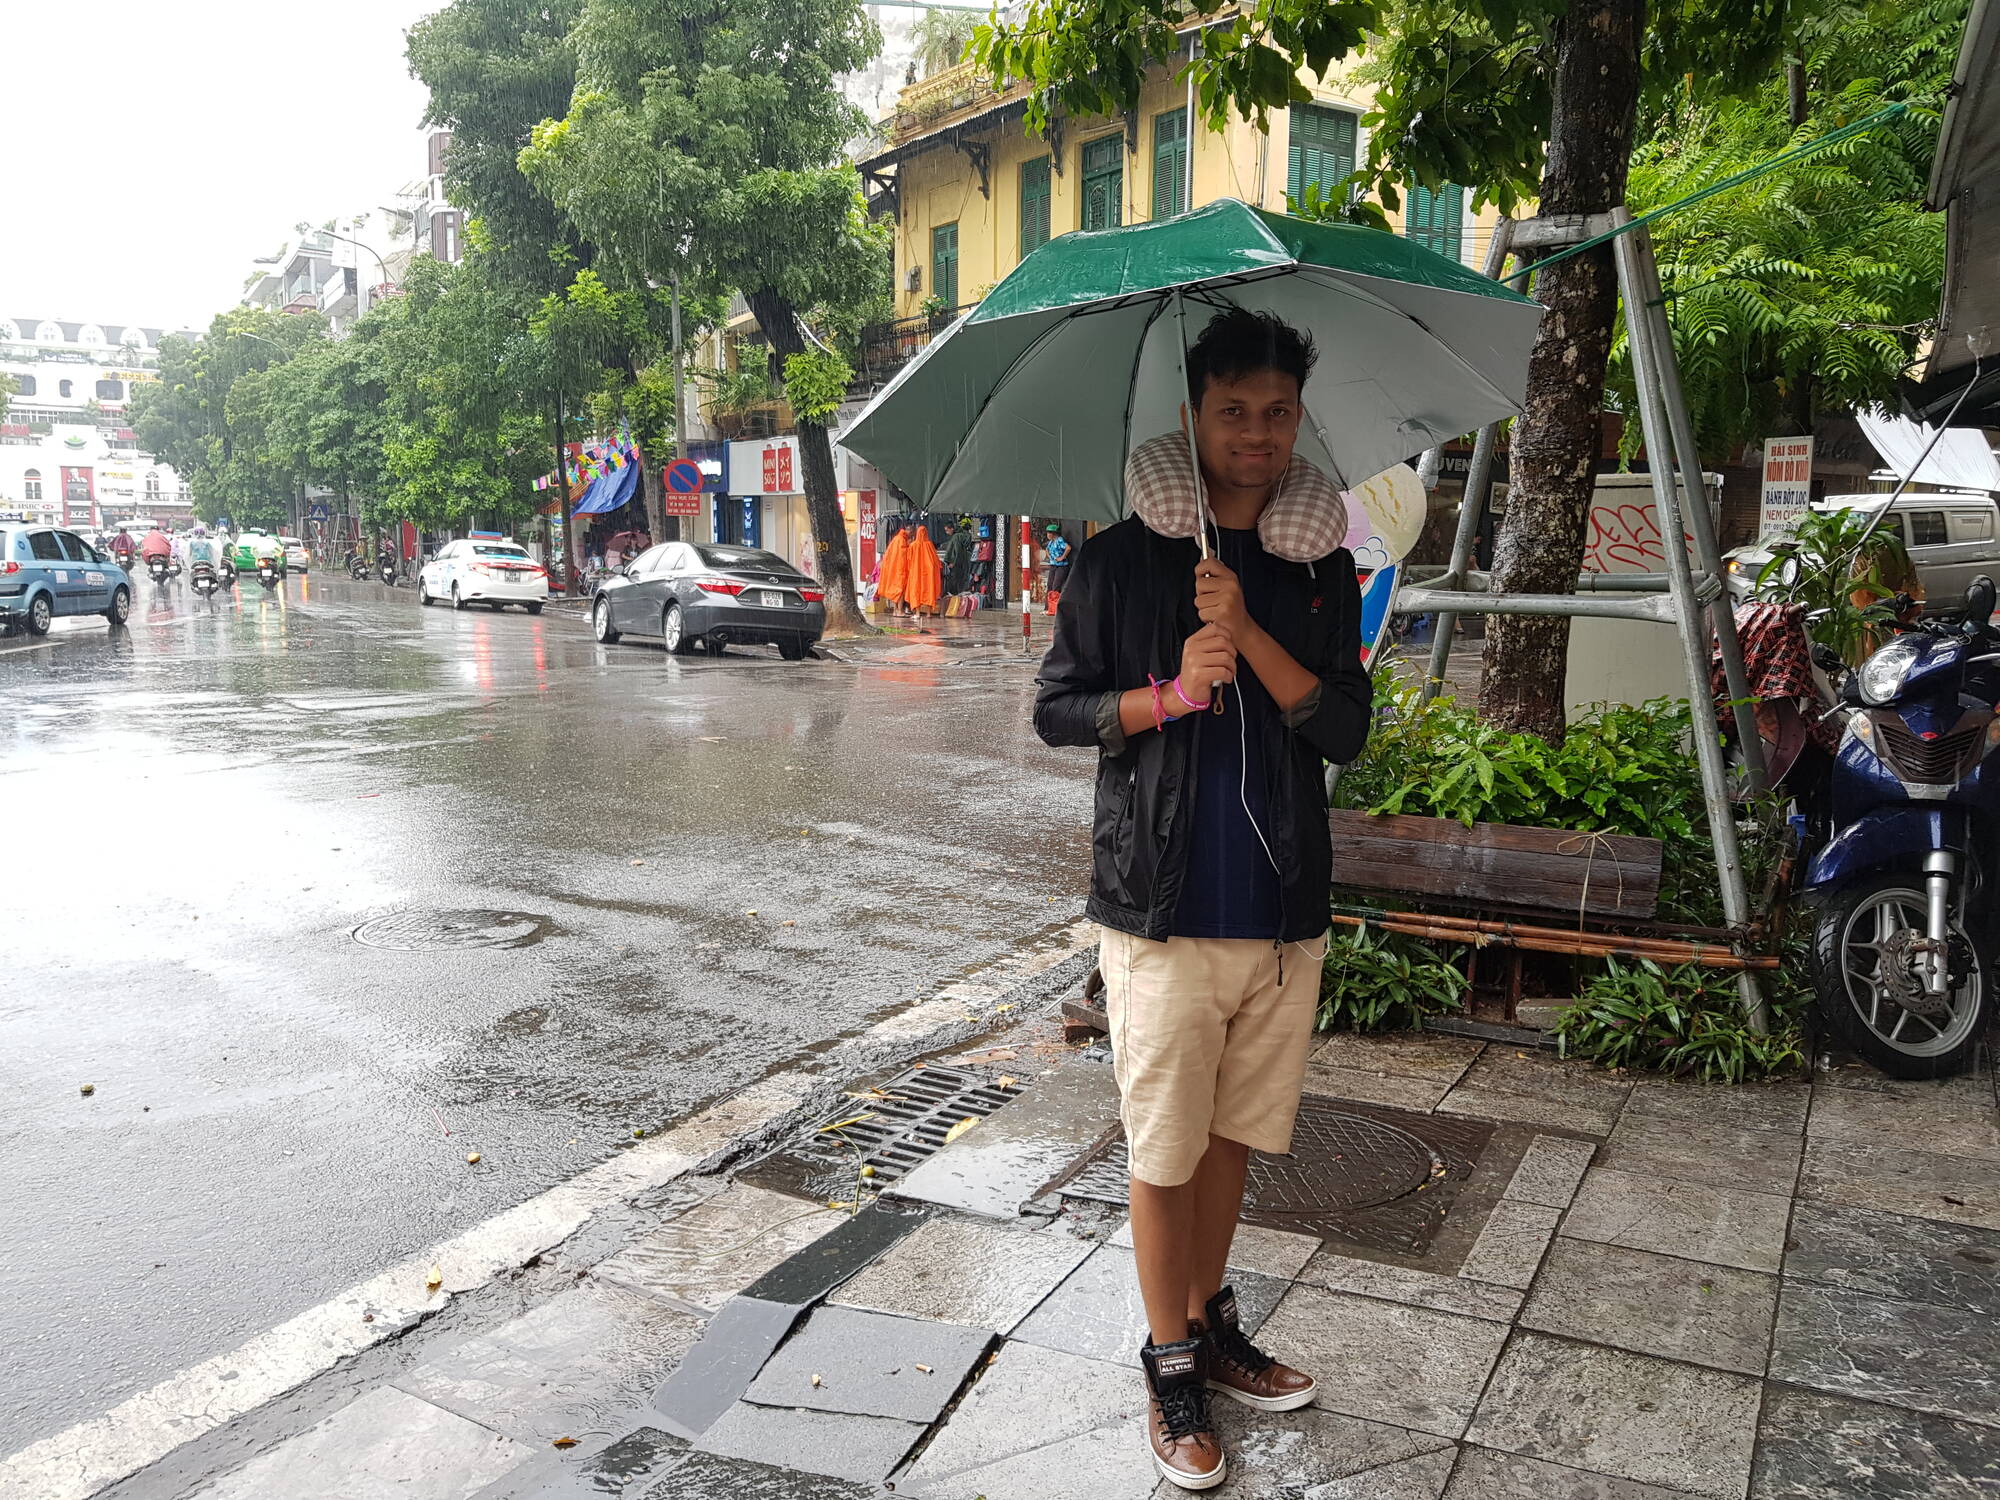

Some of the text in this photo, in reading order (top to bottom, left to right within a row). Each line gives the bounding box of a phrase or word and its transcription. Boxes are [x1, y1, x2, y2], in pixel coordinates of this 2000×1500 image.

[1787, 444, 1808, 456] SINH
[763, 458, 776, 470] MINI
[1765, 487, 1783, 505] BÁNH
[1795, 490, 1807, 508] LỌC
[18, 503, 40, 511] HSBC
[1765, 509, 1782, 521] NEM
[1175, 1363, 1192, 1371] STAR
